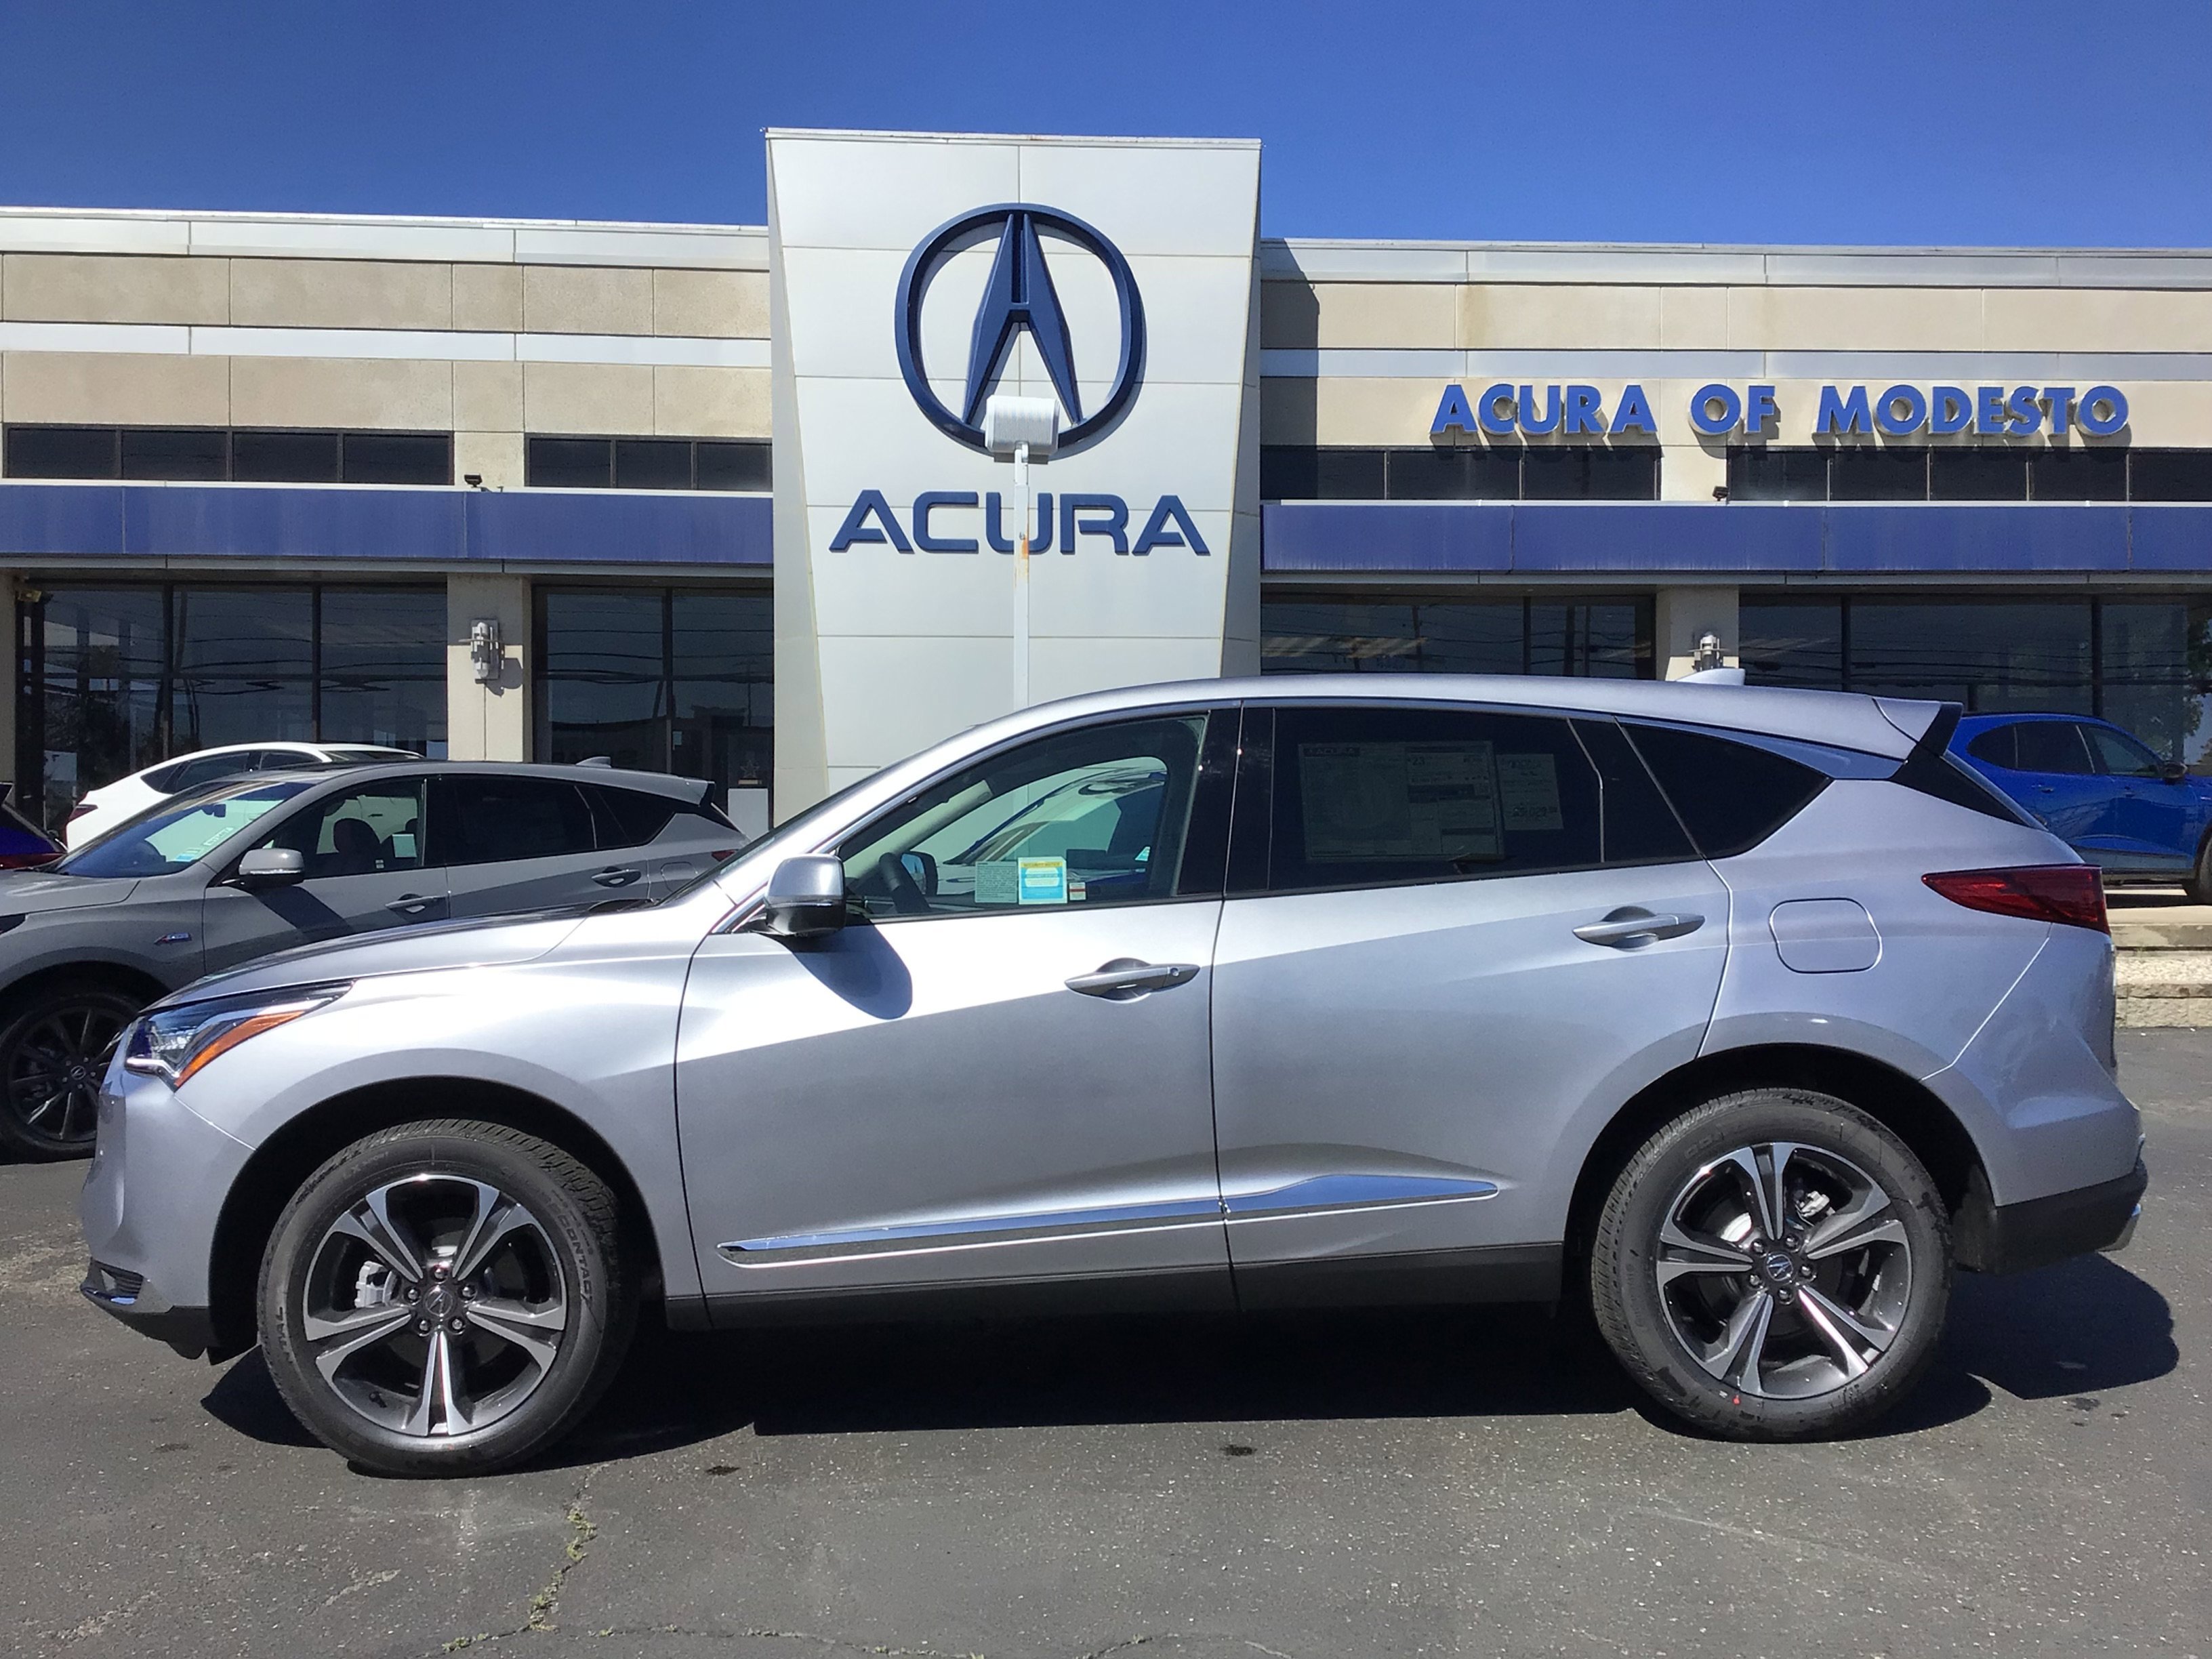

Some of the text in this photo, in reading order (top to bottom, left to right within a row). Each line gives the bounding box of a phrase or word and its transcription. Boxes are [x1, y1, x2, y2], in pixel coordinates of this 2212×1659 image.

[1429, 383, 2129, 436] ACURA OF MODESTO
[829, 489, 1210, 556] ACURA
